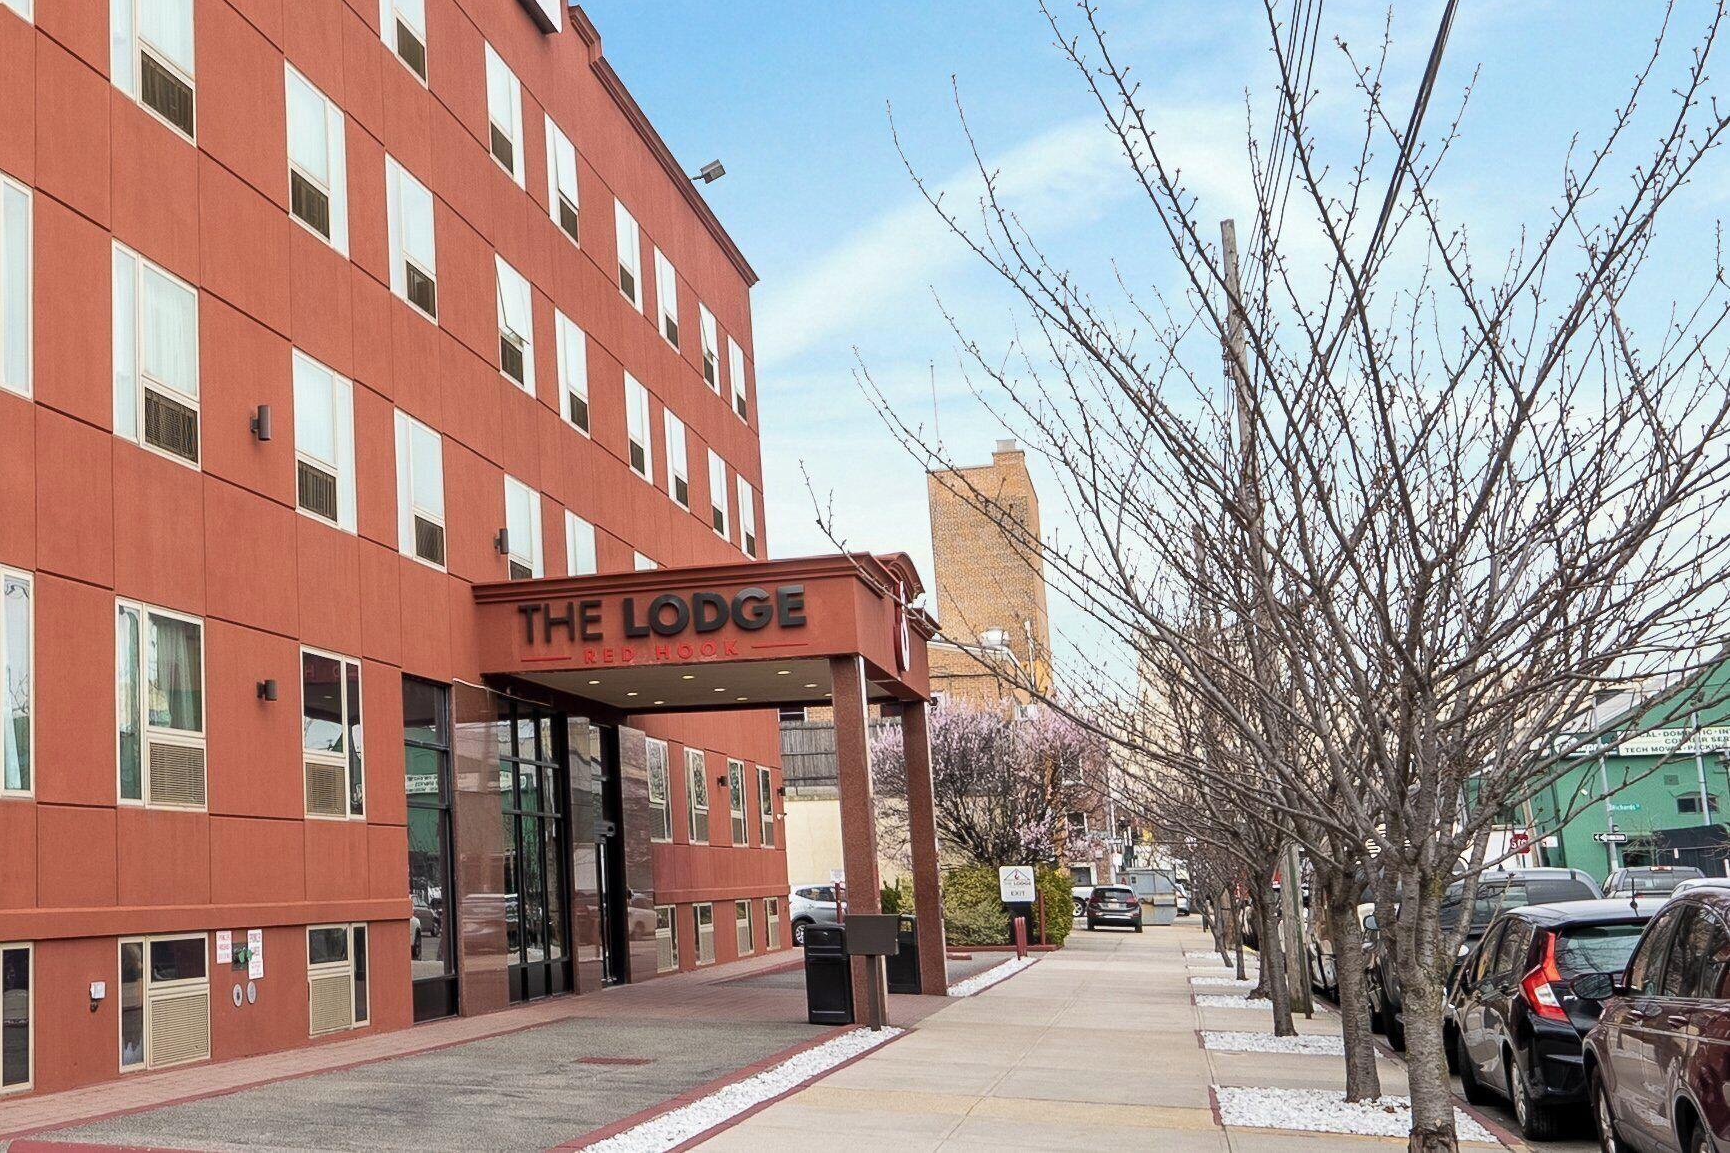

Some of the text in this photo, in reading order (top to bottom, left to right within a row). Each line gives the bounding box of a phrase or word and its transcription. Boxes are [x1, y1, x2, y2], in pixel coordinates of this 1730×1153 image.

[518, 584, 807, 643] THE LODGE
[584, 639, 738, 664] RED HOOK
[1511, 838, 1528, 848] STO
